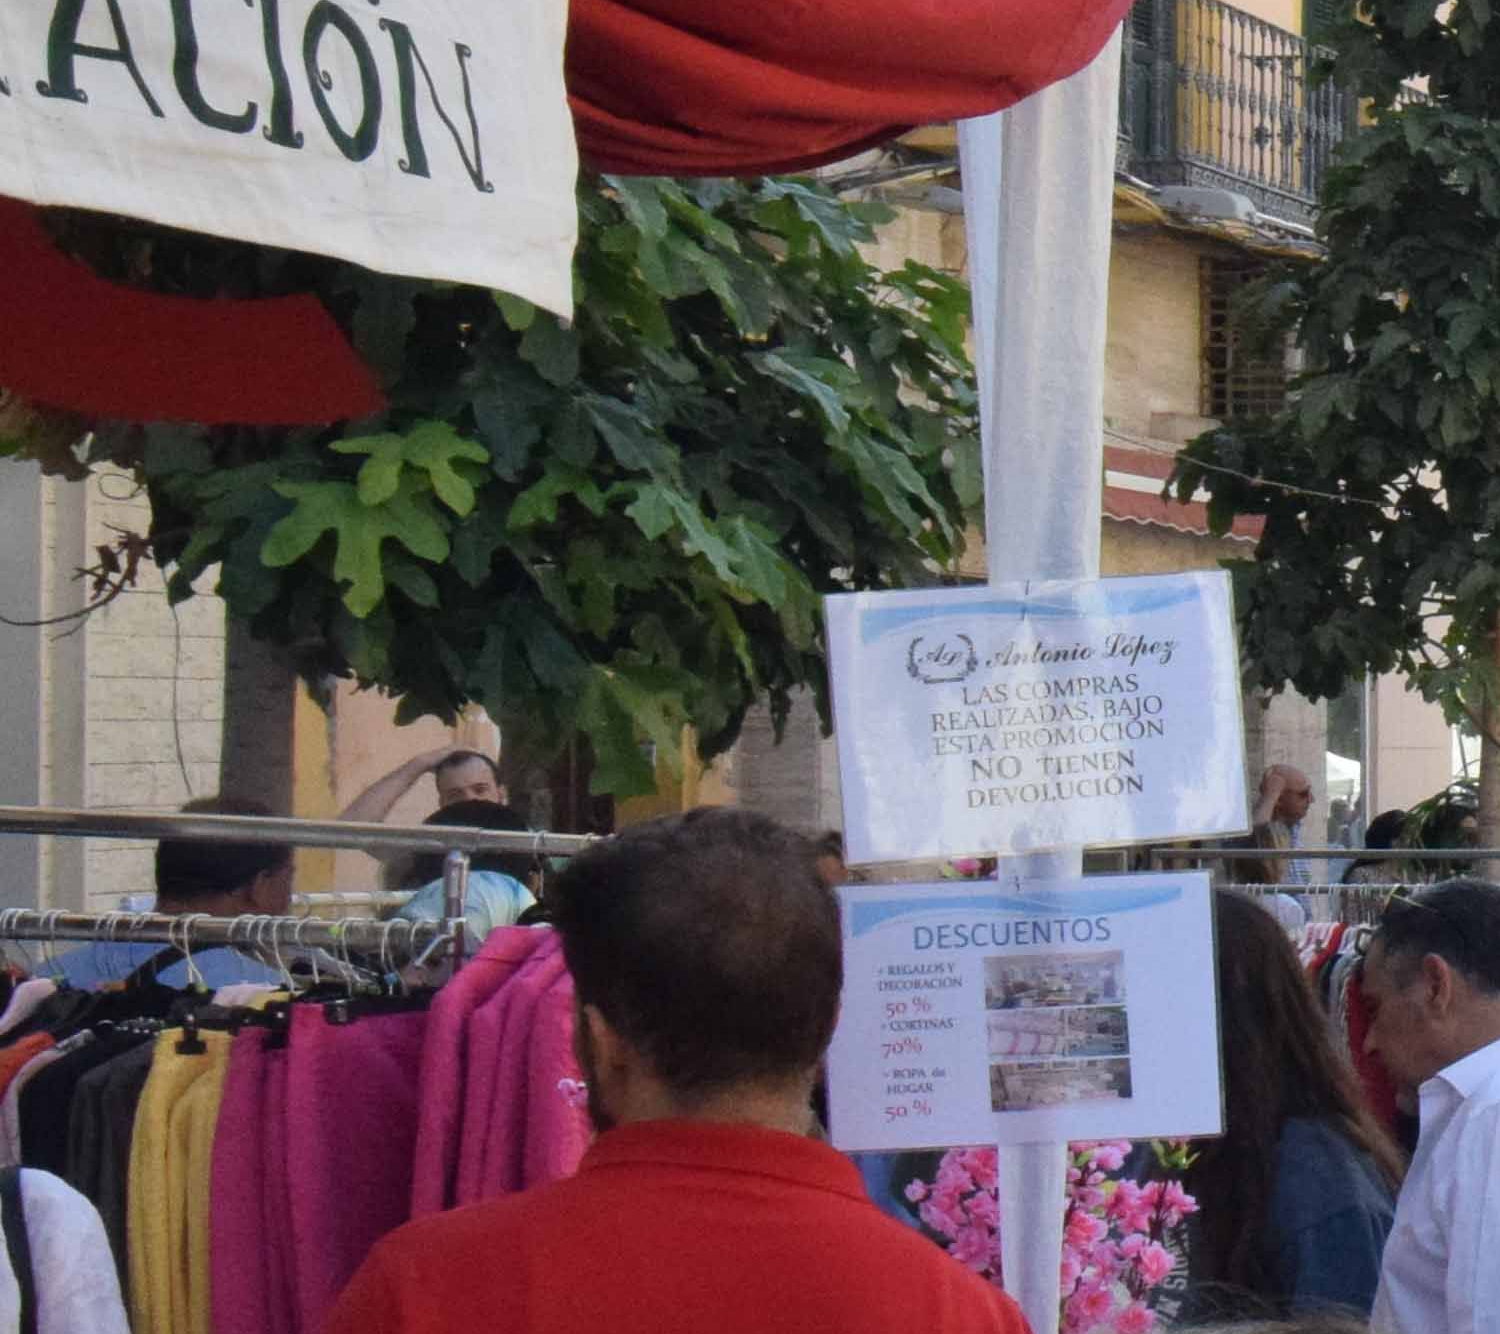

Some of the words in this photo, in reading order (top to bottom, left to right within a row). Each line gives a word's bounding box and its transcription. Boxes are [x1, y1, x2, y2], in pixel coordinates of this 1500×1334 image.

[985, 639, 1092, 668] Antonio
[1104, 632, 1178, 668] López
[961, 682, 1009, 706] LAS
[1015, 673, 1139, 702] COMPRAS
[1103, 695, 1163, 721] BAJO
[932, 734, 996, 756] ESTA
[970, 755, 1022, 782] NO
[1035, 749, 1135, 776] TIENEN
[913, 916, 1111, 950] DESCUENTOS
[889, 1018, 955, 1032] CORTINAS
